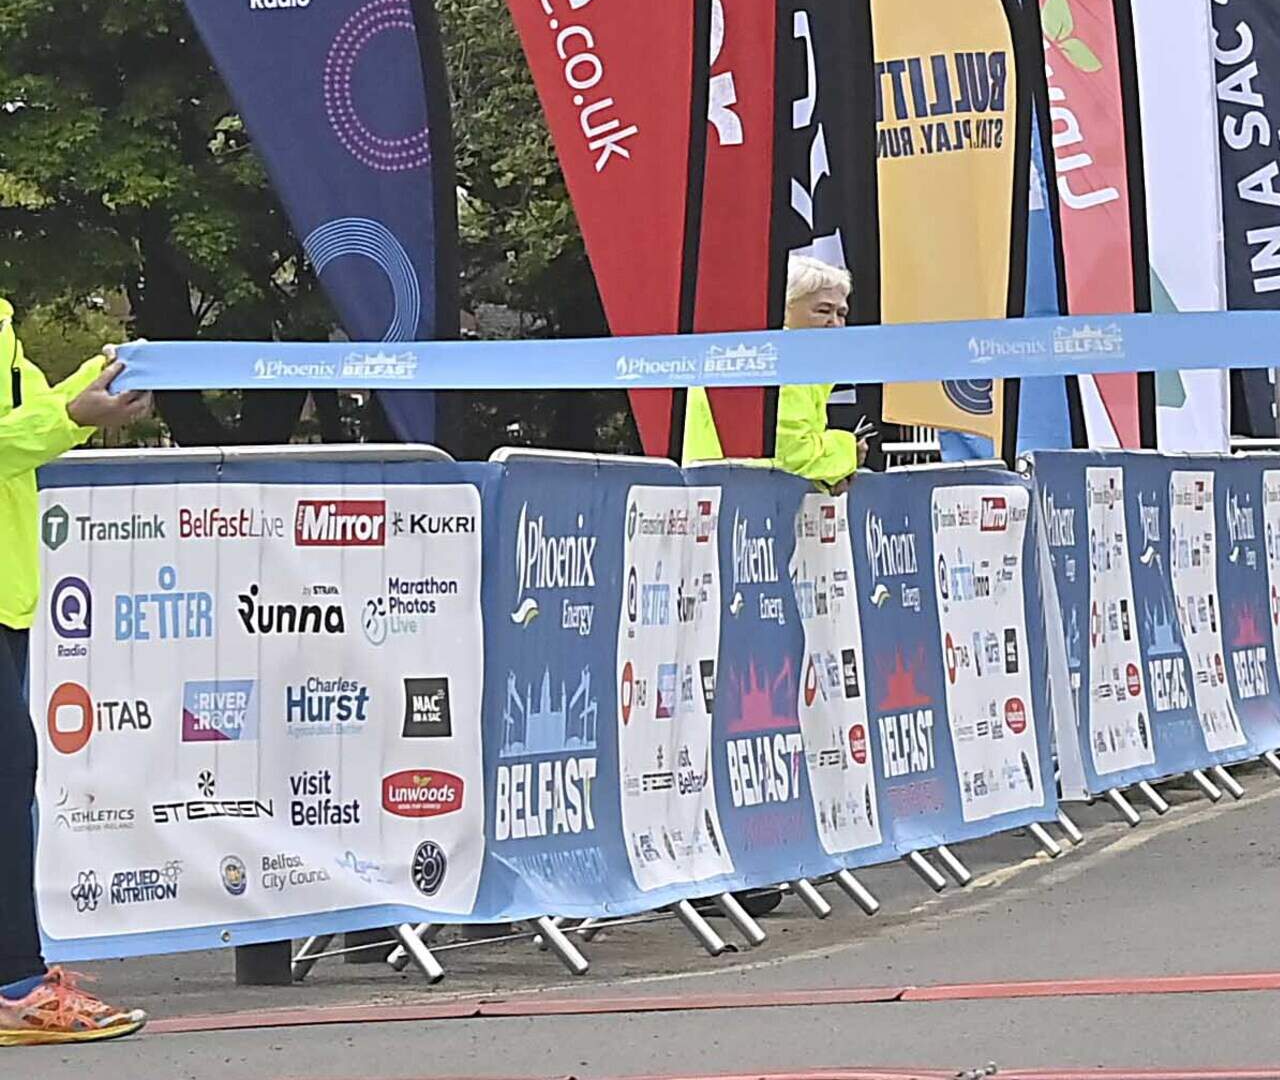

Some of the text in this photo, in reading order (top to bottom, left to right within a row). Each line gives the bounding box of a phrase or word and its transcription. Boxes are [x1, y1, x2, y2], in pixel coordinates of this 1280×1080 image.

[1212, 21, 1273, 152] SAC
[76, 514, 165, 541] Translink
[179, 507, 285, 539] BelfastLive
[301, 504, 384, 541] Mirror
[410, 513, 476, 534] KUKRI
[526, 514, 597, 589] Phoenix
[389, 577, 458, 595] Marathon
[115, 592, 213, 641] BETTER
[389, 596, 436, 615] Photos
[562, 598, 595, 636] Energy
[306, 677, 359, 693] Charles
[96, 700, 153, 732] iTAB
[287, 686, 370, 723] Hurst
[412, 695, 441, 713] MAC
[290, 770, 332, 796] visit
[388, 784, 456, 803] Linwoods
[292, 798, 361, 827] Belfast
[495, 757, 598, 841] BELFAST
[111, 869, 161, 887] APPLIED
[262, 871, 288, 891] City
[111, 883, 178, 905] NUTRITION
